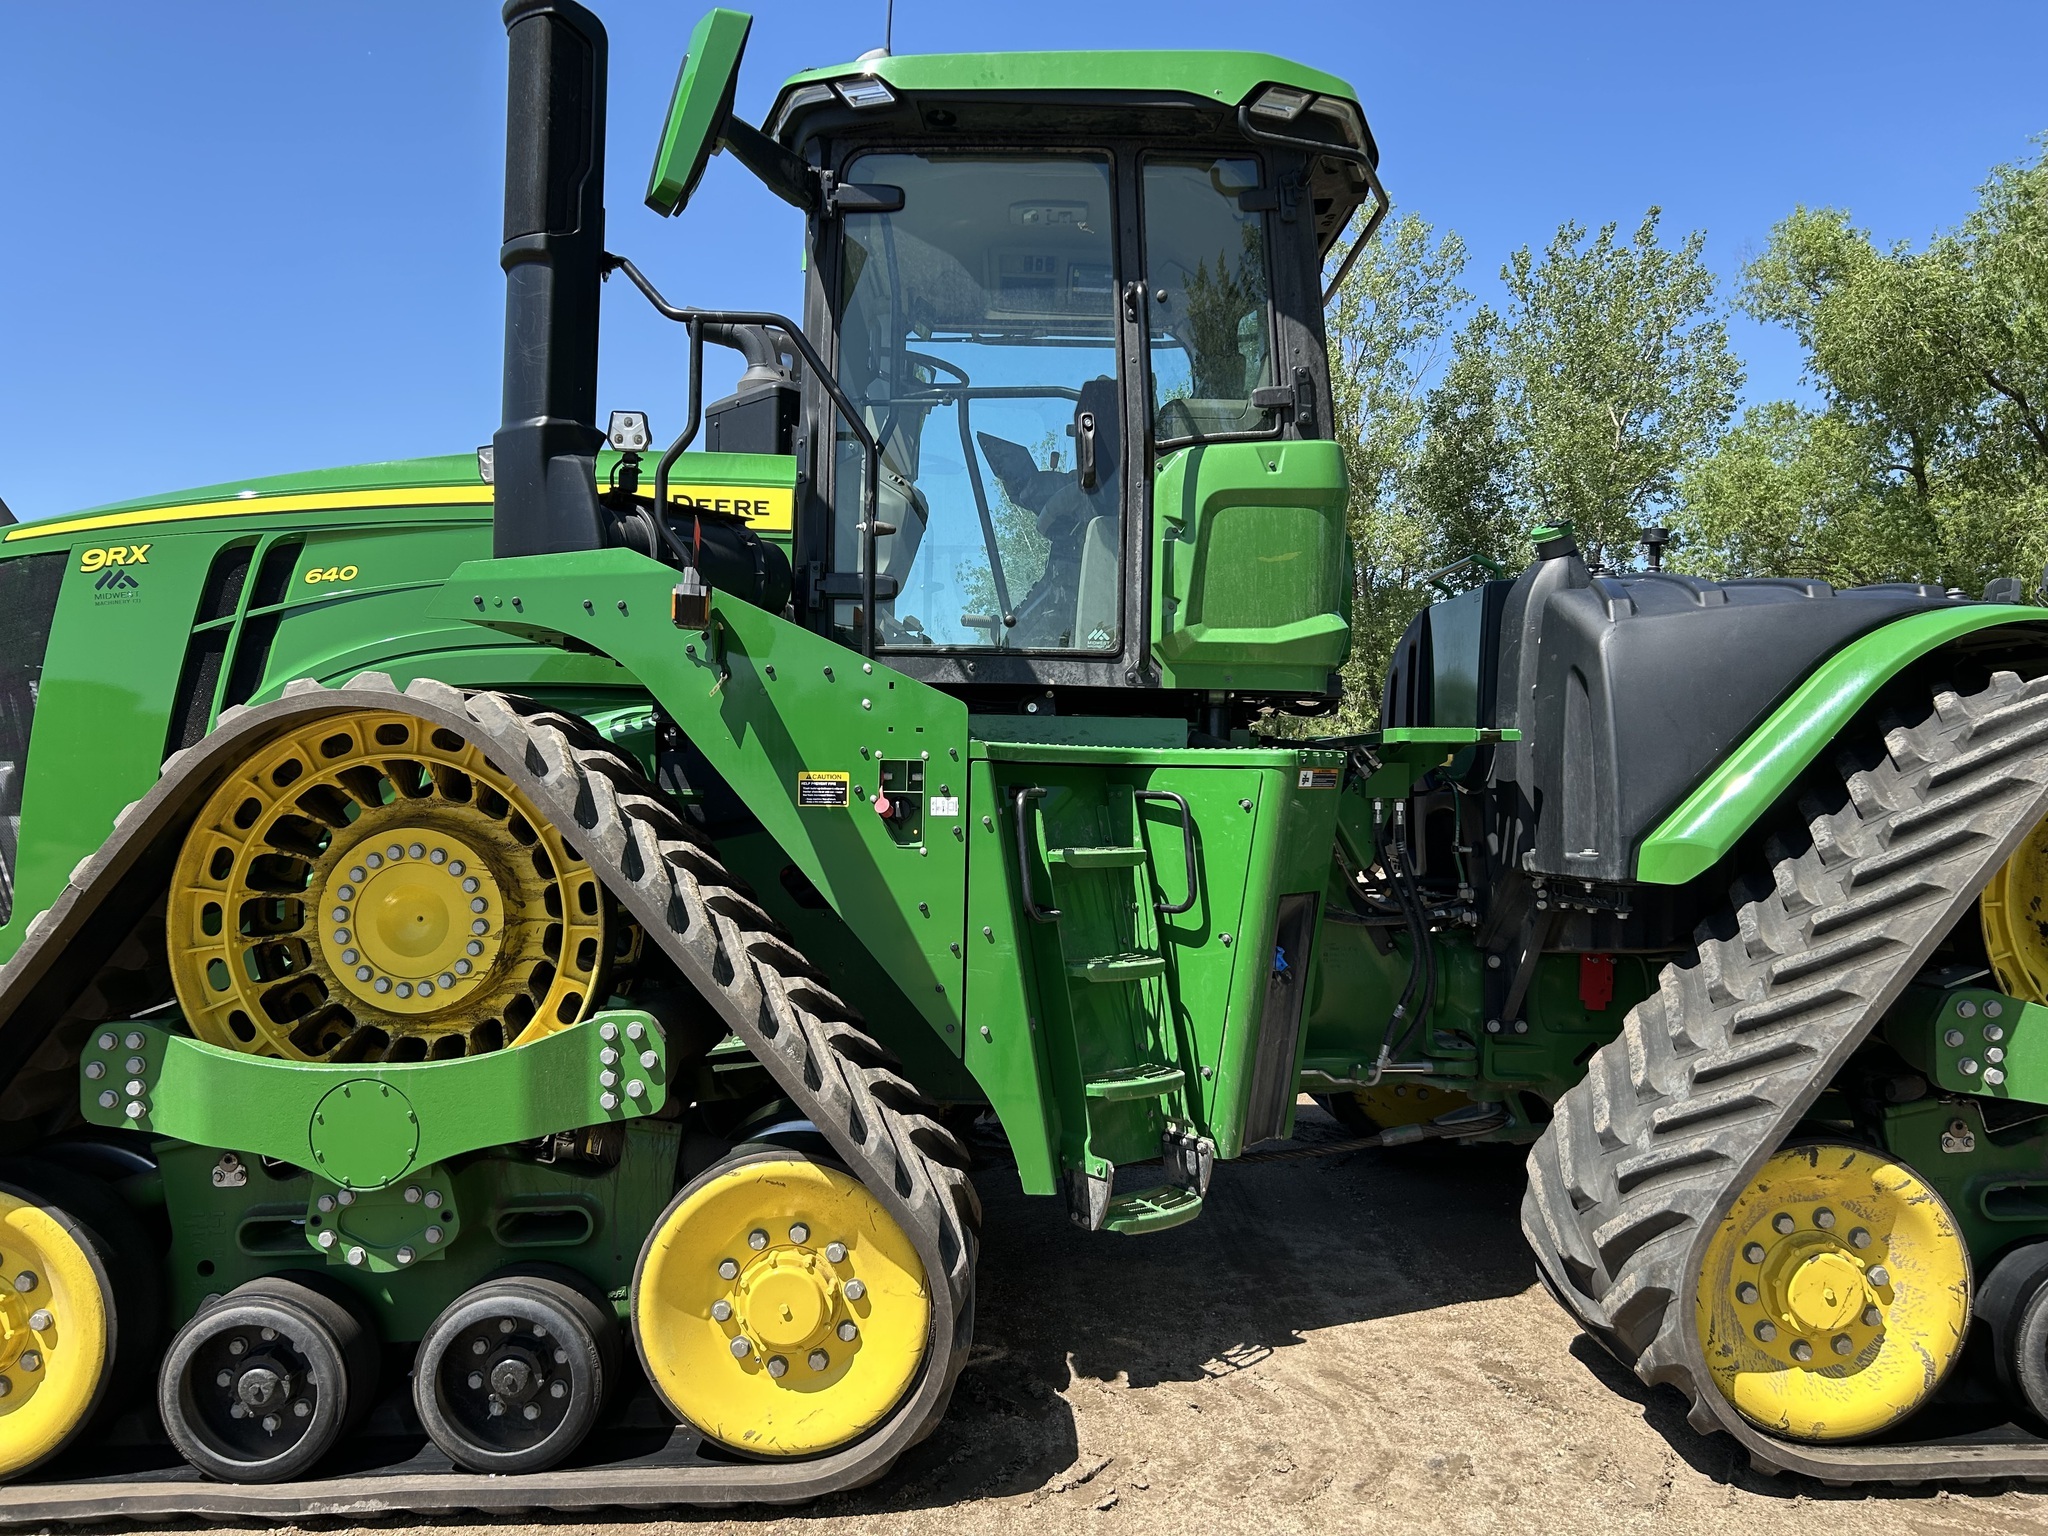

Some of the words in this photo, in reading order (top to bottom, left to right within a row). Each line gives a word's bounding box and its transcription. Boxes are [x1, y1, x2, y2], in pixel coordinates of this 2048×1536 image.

[80, 544, 153, 573] 9RX
[304, 565, 359, 584] 640
[94, 590, 140, 600] MIDWEST
